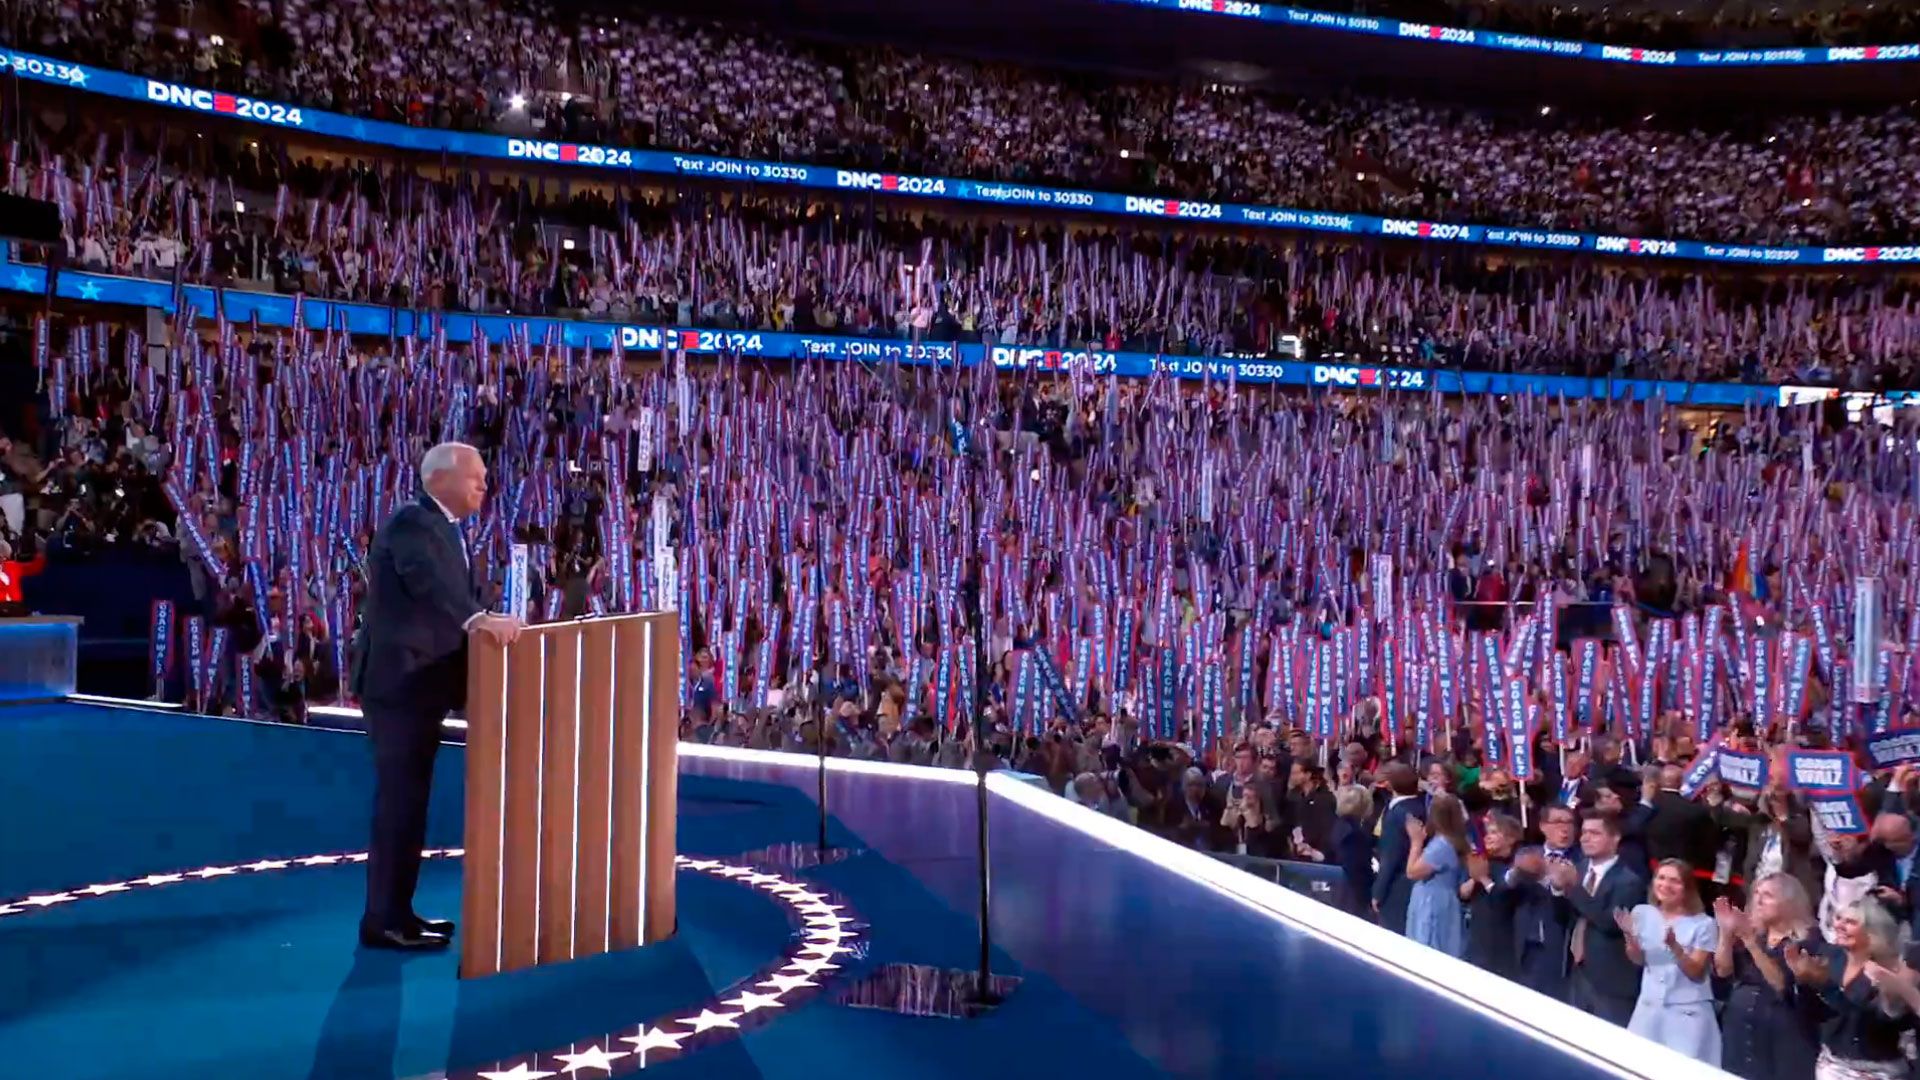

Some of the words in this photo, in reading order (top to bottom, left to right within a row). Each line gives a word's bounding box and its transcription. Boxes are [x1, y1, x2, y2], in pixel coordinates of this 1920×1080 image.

[1400, 23, 1430, 38] DNC
[1440, 27, 1474, 42] 2024
[1829, 47, 1865, 60] DNC
[148, 81, 212, 109] DNC
[236, 99, 302, 124] 2024
[509, 140, 559, 159] DNC
[577, 146, 632, 165] 2024
[674, 157, 703, 169] Text
[708, 161, 741, 173] JOIN
[745, 165, 759, 176] to
[764, 166, 806, 179] 30330
[838, 171, 882, 189] DNC
[897, 177, 945, 193] 2024
[1055, 192, 1093, 205] 30330
[1126, 197, 1164, 214] DNC
[1178, 202, 1221, 217] 2024
[1243, 209, 1265, 220] Text
[1269, 212, 1296, 222] JOIN
[1313, 215, 1348, 228] 30330
[1383, 219, 1419, 236] DNC
[1824, 248, 1865, 261] DNC
[1239, 364, 1283, 378] 30330
[1315, 366, 1359, 385] DNC
[158, 603, 168, 640] COACH
[1322, 644, 1331, 692] COACH
[1486, 637, 1502, 685] COACH
[1511, 680, 1523, 729] COACH
[1512, 734, 1527, 776] WALZ
[1795, 757, 1842, 770] COACH
[1720, 765, 1759, 785] WALZ
[1795, 769, 1843, 785] WALZ
